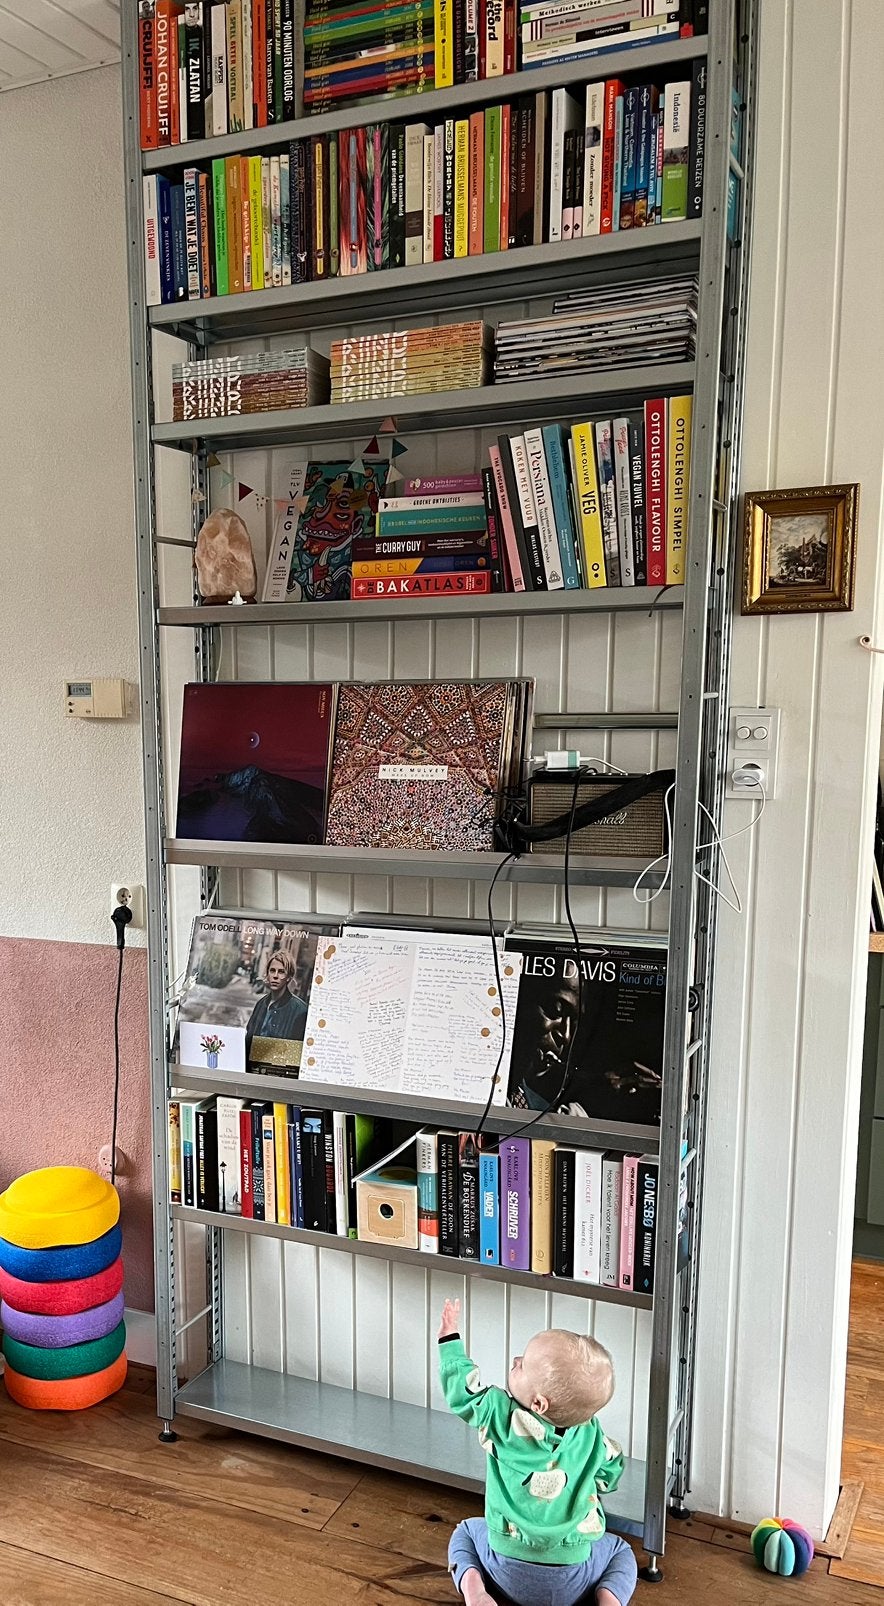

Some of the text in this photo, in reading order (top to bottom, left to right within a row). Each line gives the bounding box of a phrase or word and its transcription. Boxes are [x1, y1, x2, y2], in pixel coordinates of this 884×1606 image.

[142, 20, 152, 89] CRUIJFF!
[284, 20, 293, 102] 90 MINUTEN OORLOG
[158, 12, 168, 135] JOHAN CRUIJFF
[190, 58, 200, 102] ZLATAN
[522, 152, 526, 160] OF
[695, 94, 705, 188] 80 DUURZAME REIZEN
[147, 218, 156, 259] UITGEWOOND
[185, 182, 198, 272] JE BENT WAT JE DOET
[496, 469, 504, 492] AVOCADO
[515, 445, 525, 473] KOKEN
[524, 499, 533, 520] VUUR
[531, 451, 547, 506] Persiana
[633, 454, 643, 508] VEGAN ZUIVEL
[651, 412, 661, 552] OTTOLENGHI FLAVOUR
[673, 418, 685, 551] OTTOLENGHI SIMPEL
[581, 492, 597, 514] VEG
[382, 542, 406, 553] CURRY
[407, 541, 421, 551] GUY
[360, 562, 407, 574] OREN
[200, 922, 309, 939] TOM ODELL LONG WAY DOWN
[563, 958, 616, 982] DAVIS
[619, 972, 654, 985] Kind of
[442, 1160, 447, 1168] DE
[644, 1173, 656, 1188] JO
[448, 1203, 453, 1211] DE
[484, 1191, 494, 1217] VADER
[508, 1191, 518, 1240] SCHRIJVER
[643, 1232, 652, 1266] KONINKRIJK
